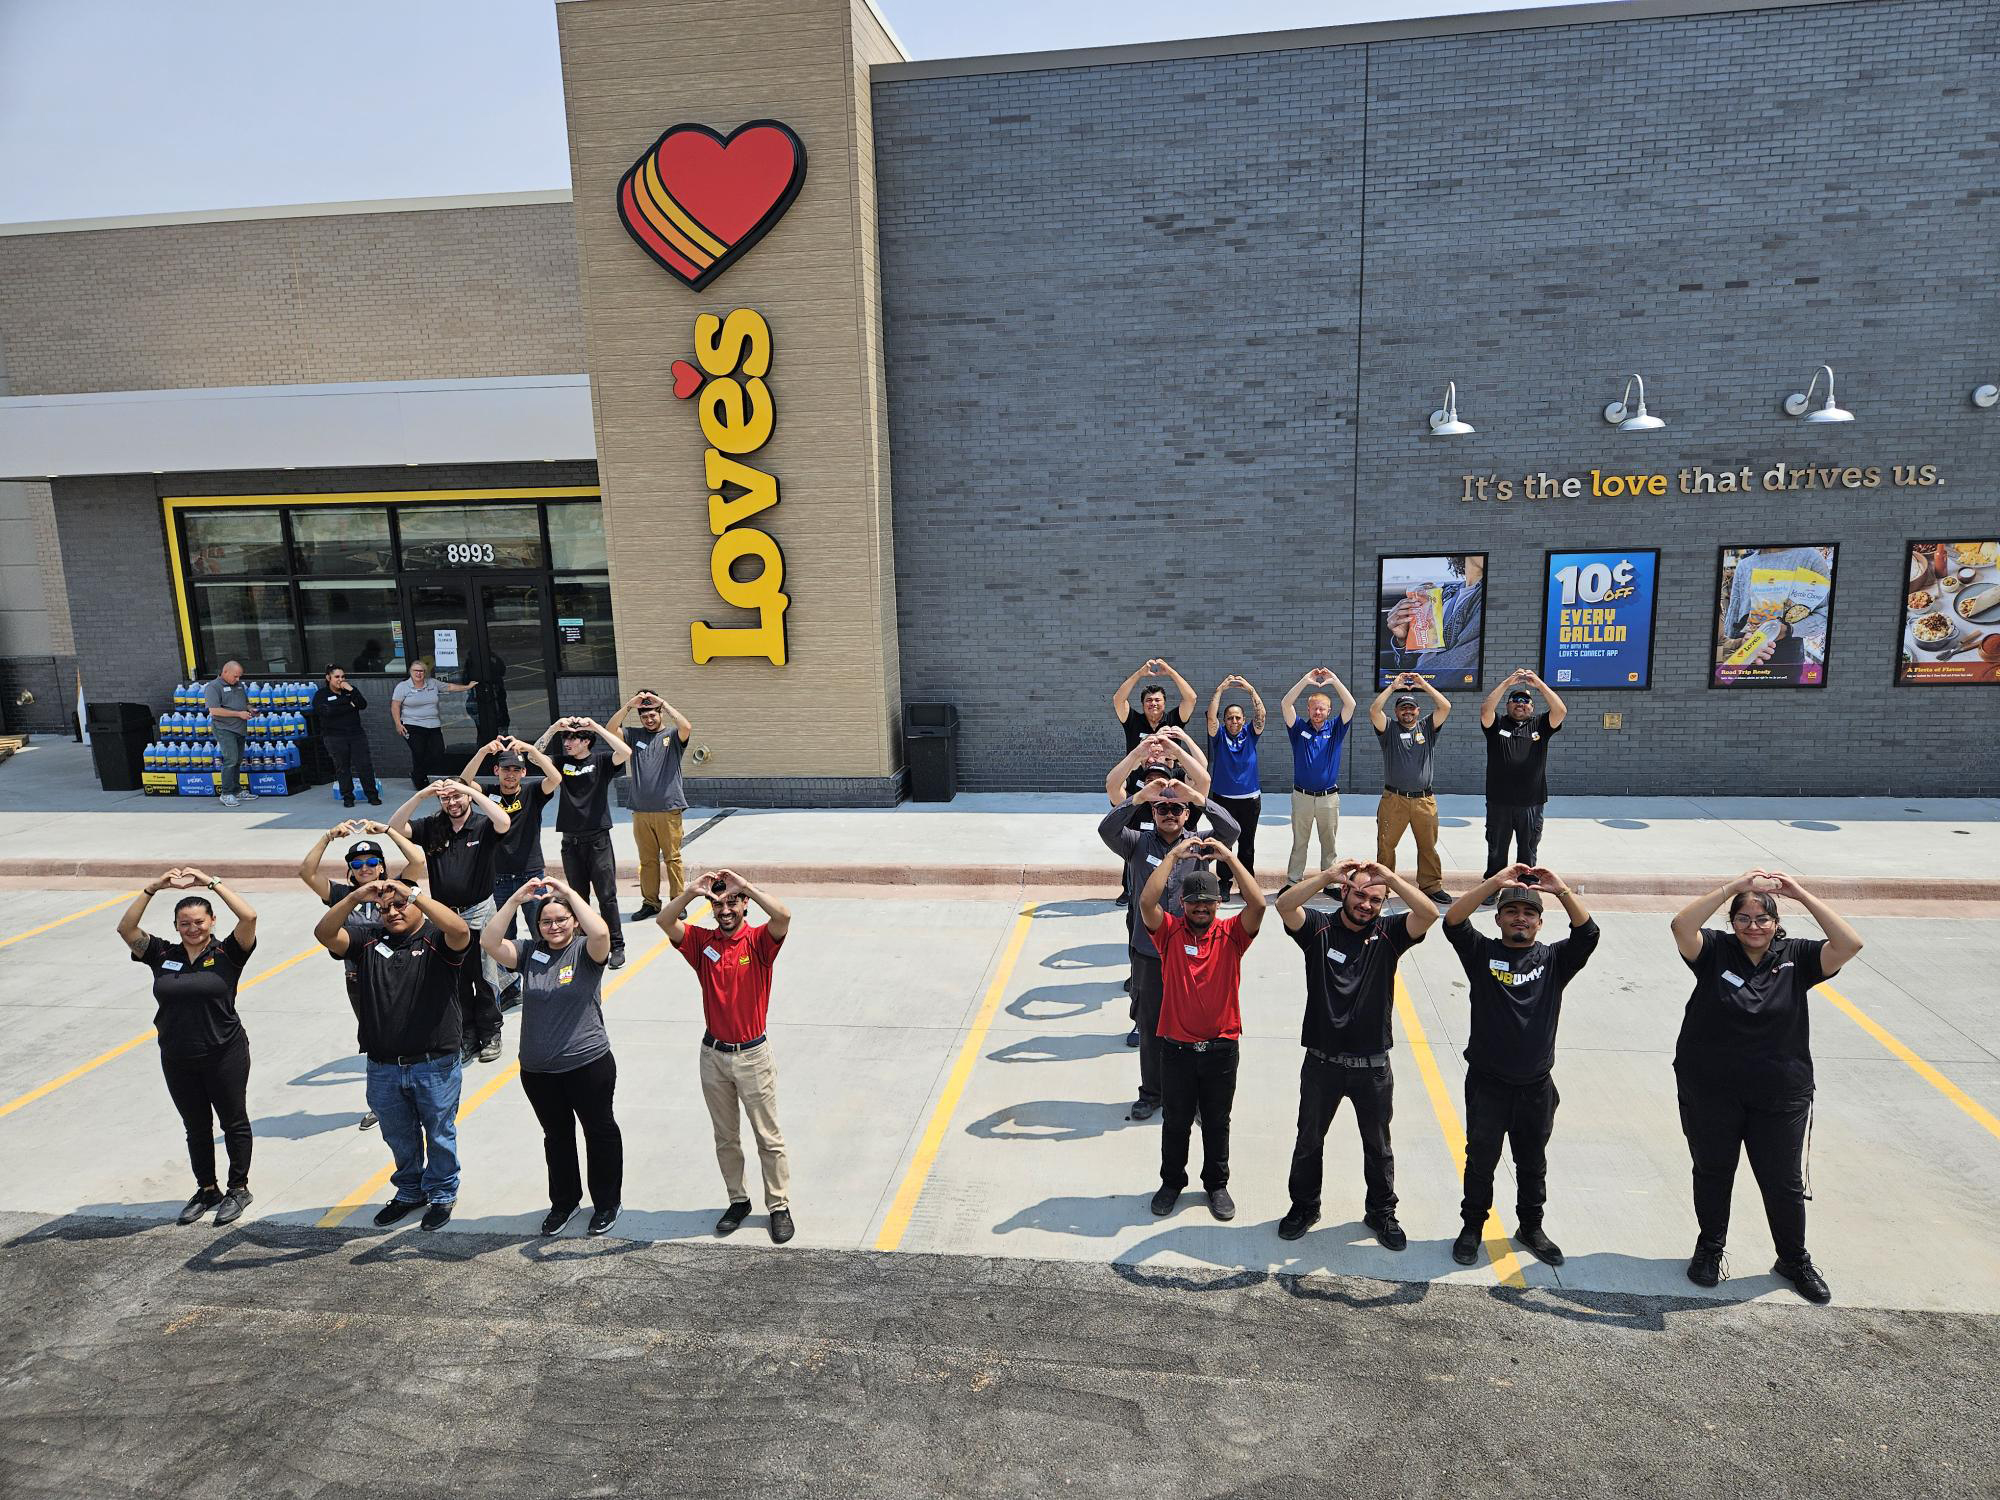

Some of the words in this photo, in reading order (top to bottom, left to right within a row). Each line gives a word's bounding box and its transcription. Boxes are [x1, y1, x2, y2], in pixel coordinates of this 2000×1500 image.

[671, 308, 791, 667] Love's
[1461, 473, 1513, 502] It's
[1523, 472, 1581, 499] the
[1590, 469, 1668, 497] love
[1677, 466, 1752, 494] that
[1763, 462, 1881, 491] drives
[1893, 464, 1945, 487] us.
[447, 543, 495, 563] 8993
[1603, 586, 1635, 602] OFF
[1560, 608, 1616, 626] EVERY
[1559, 625, 1627, 643] GALLON
[1559, 650, 1579, 658] LOVE'S
[1606, 649, 1619, 657] APP
